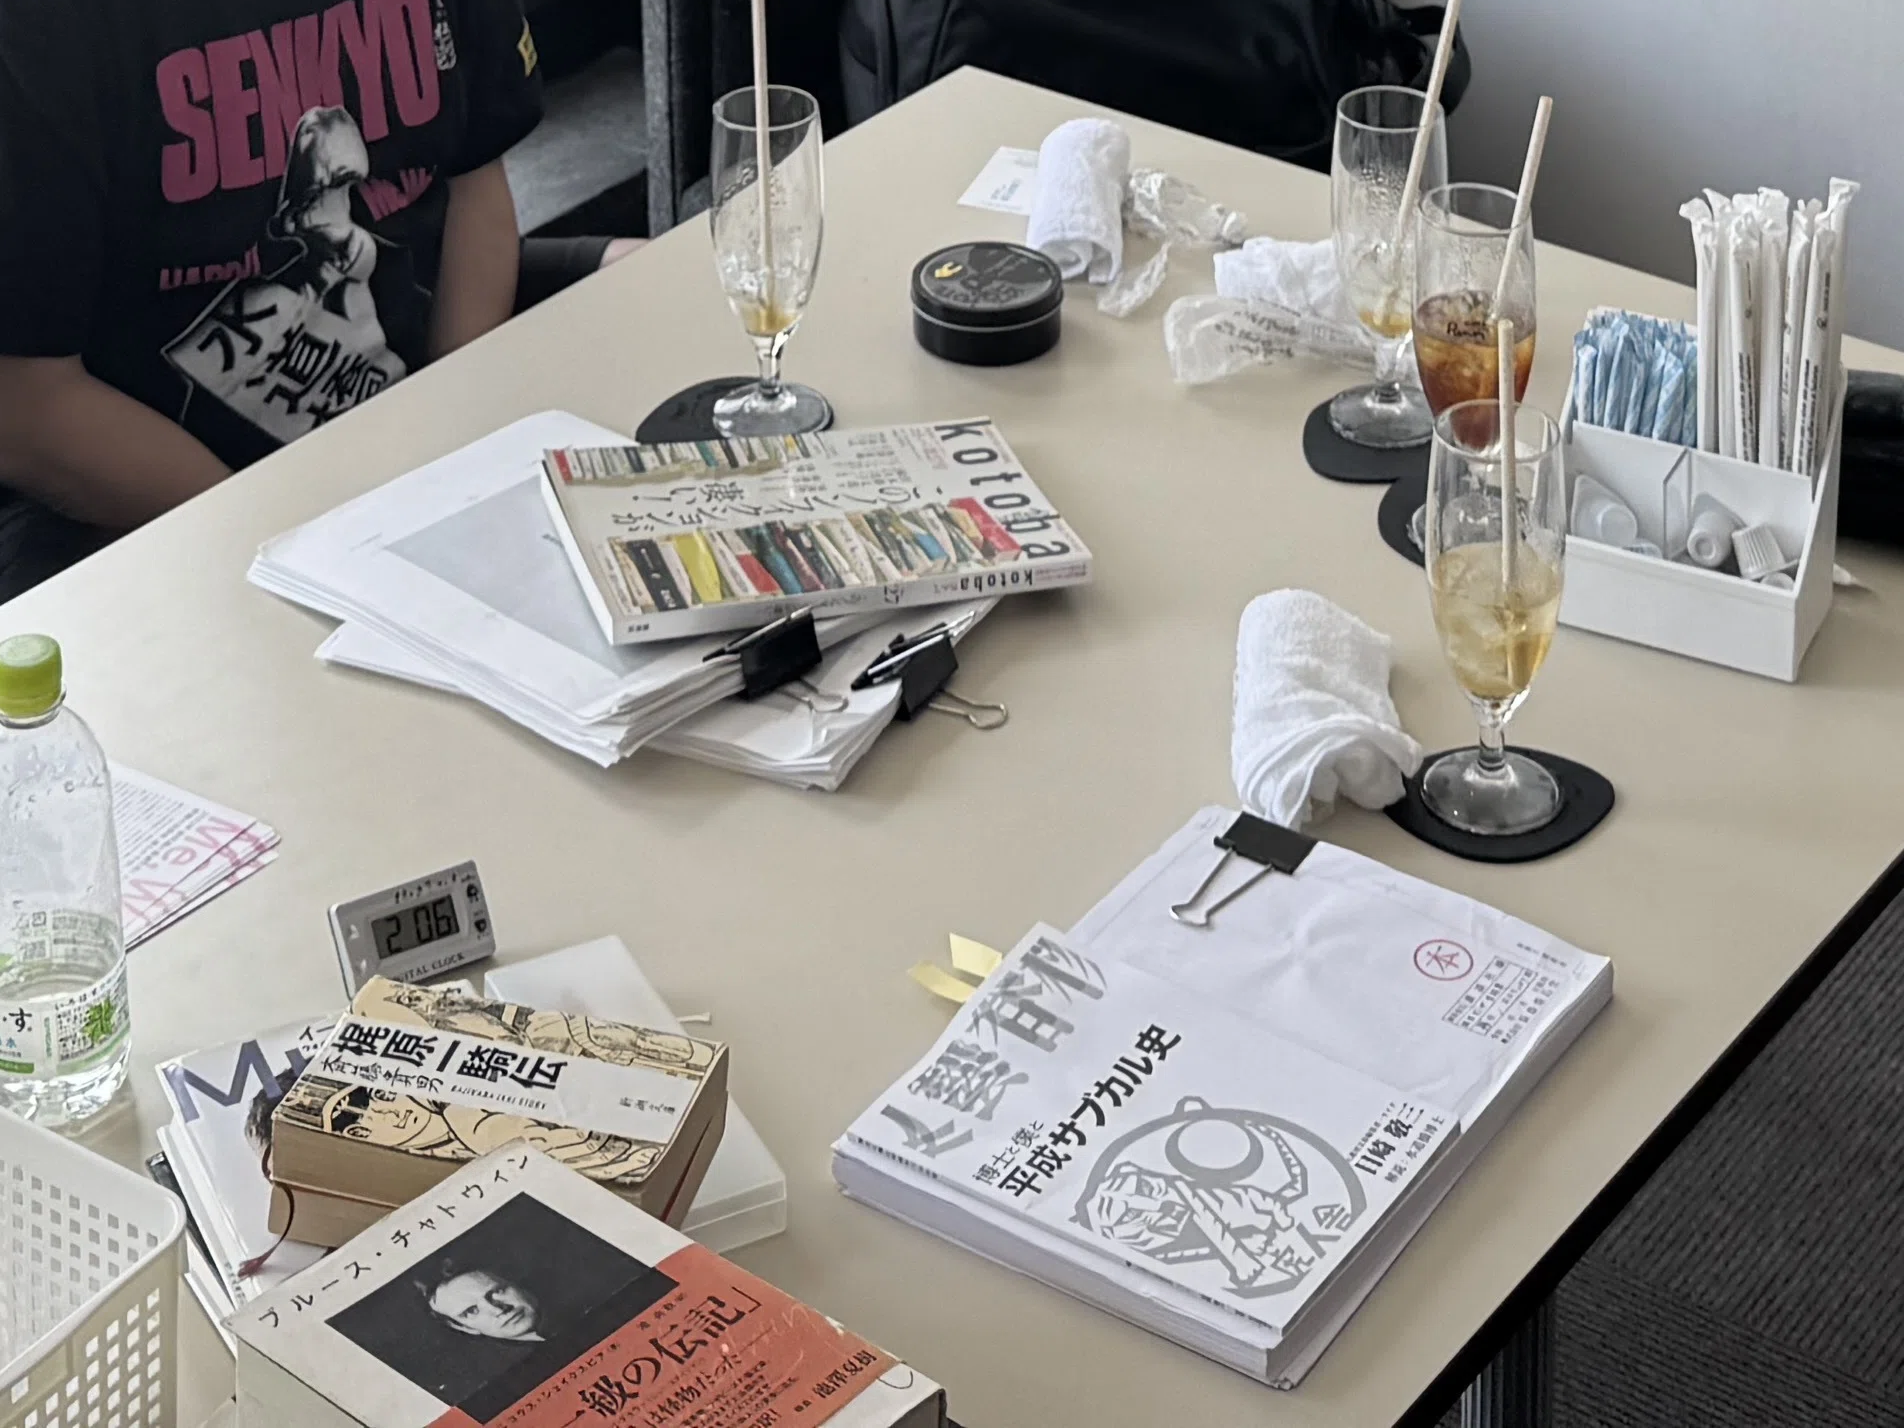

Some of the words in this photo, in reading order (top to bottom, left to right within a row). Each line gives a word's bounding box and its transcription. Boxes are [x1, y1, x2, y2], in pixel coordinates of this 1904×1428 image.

[934, 418, 1071, 560] kotoba
[960, 568, 1034, 594] kotoba
[431, 951, 465, 970] CLOCK
[331, 1021, 569, 1091] 梶原一騎伝
[998, 1023, 1182, 1199] 平成サブカル史
[971, 1119, 1045, 1186] 博士と僕と
[258, 1155, 528, 1328] ブルース・チャトウィン
